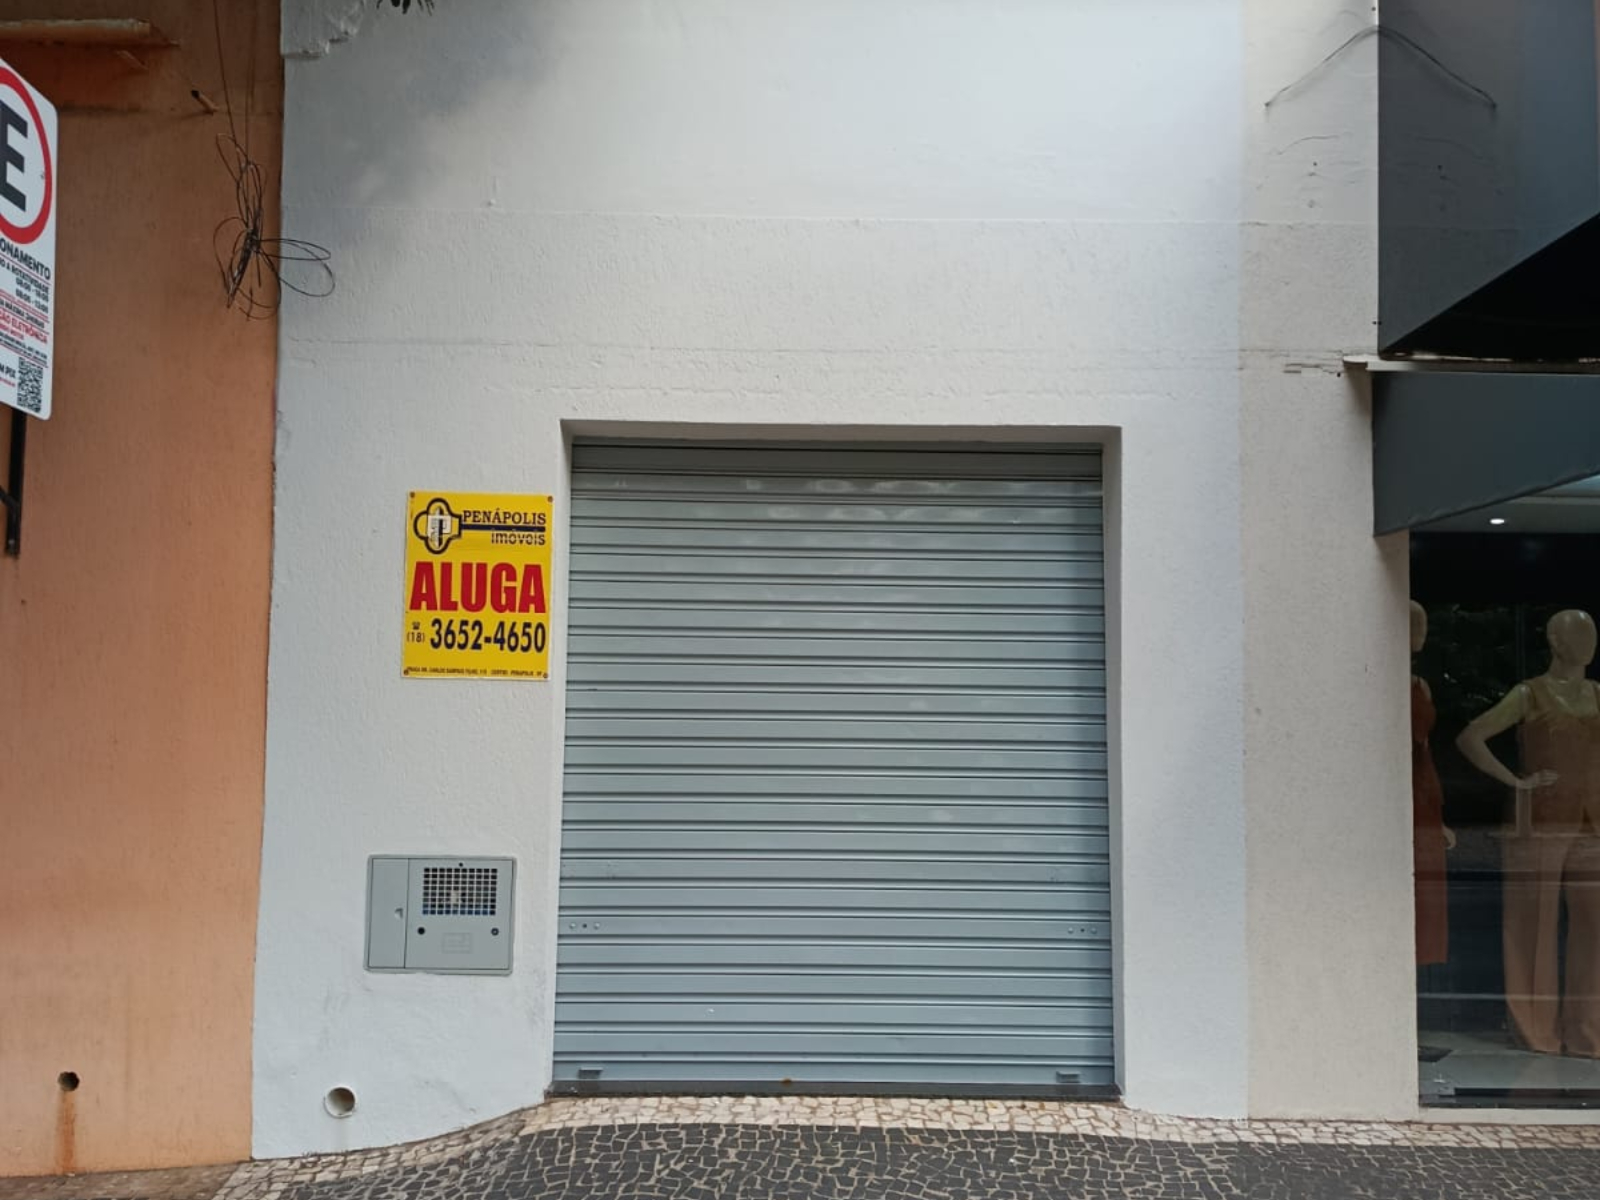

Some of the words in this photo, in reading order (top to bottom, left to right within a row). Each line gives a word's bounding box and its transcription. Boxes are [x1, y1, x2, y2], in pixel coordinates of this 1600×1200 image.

[0, 99, 28, 212] E
[463, 508, 546, 525] PENÁPOLIS
[491, 529, 546, 546] imóveis
[410, 561, 546, 613] ALUGA
[407, 632, 425, 643] (18)
[430, 618, 546, 653] 3652-4650
